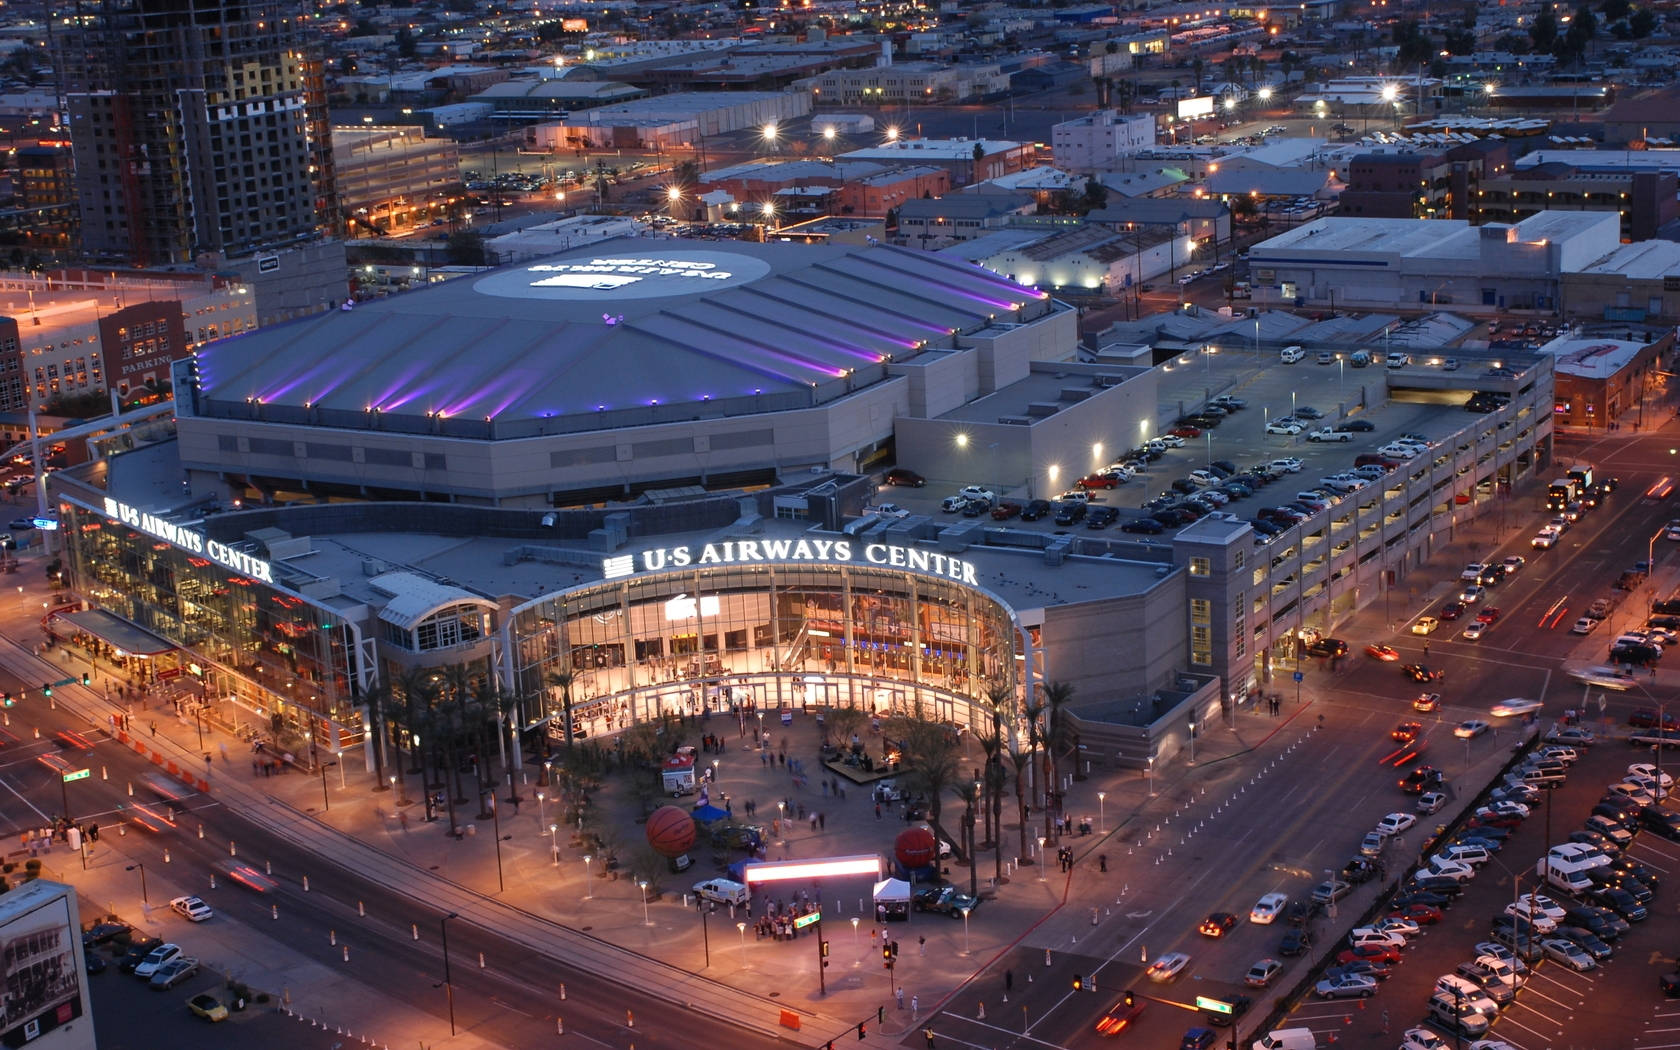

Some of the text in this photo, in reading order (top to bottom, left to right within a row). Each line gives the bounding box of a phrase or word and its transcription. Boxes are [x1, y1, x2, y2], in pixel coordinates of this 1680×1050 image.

[121, 355, 172, 375] PARKING
[141, 513, 204, 553] AIRWAYS
[206, 540, 274, 584] CENTER
[699, 540, 852, 564] AIRWAYS
[865, 544, 979, 587] CENTER
